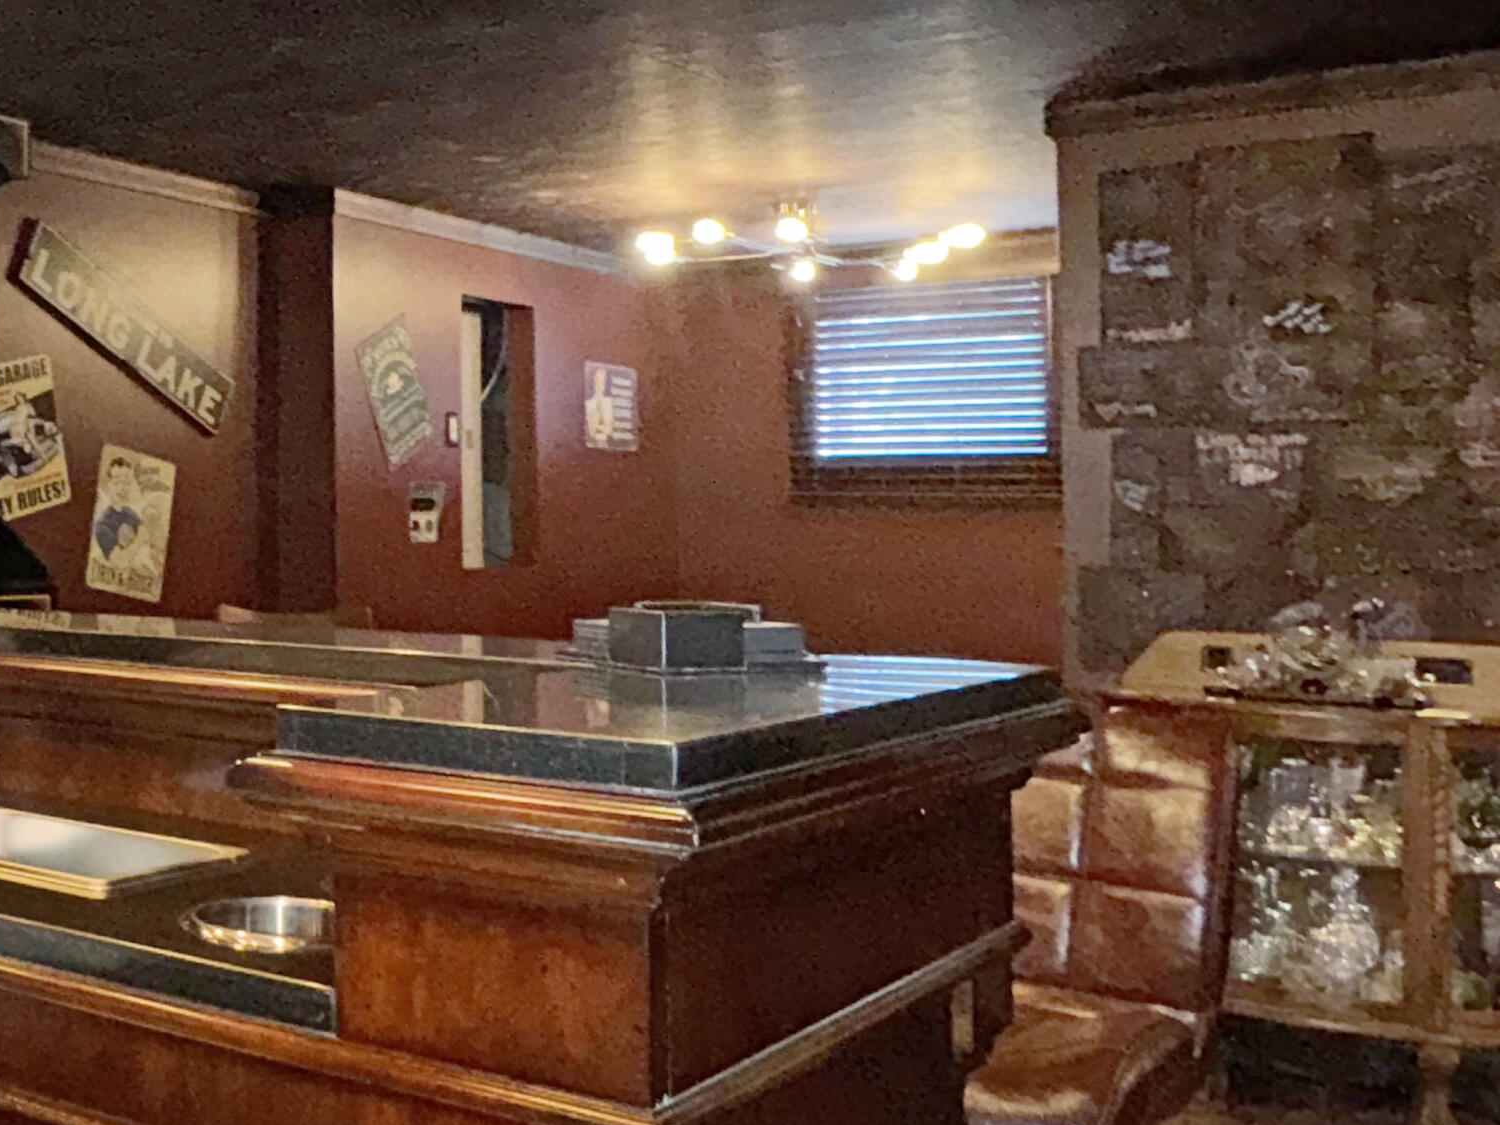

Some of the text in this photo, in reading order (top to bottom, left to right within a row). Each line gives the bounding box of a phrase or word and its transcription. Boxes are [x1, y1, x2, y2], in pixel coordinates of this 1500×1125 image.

[31, 248, 223, 425] LONG LAKE
[18, 480, 65, 511] RULES!
